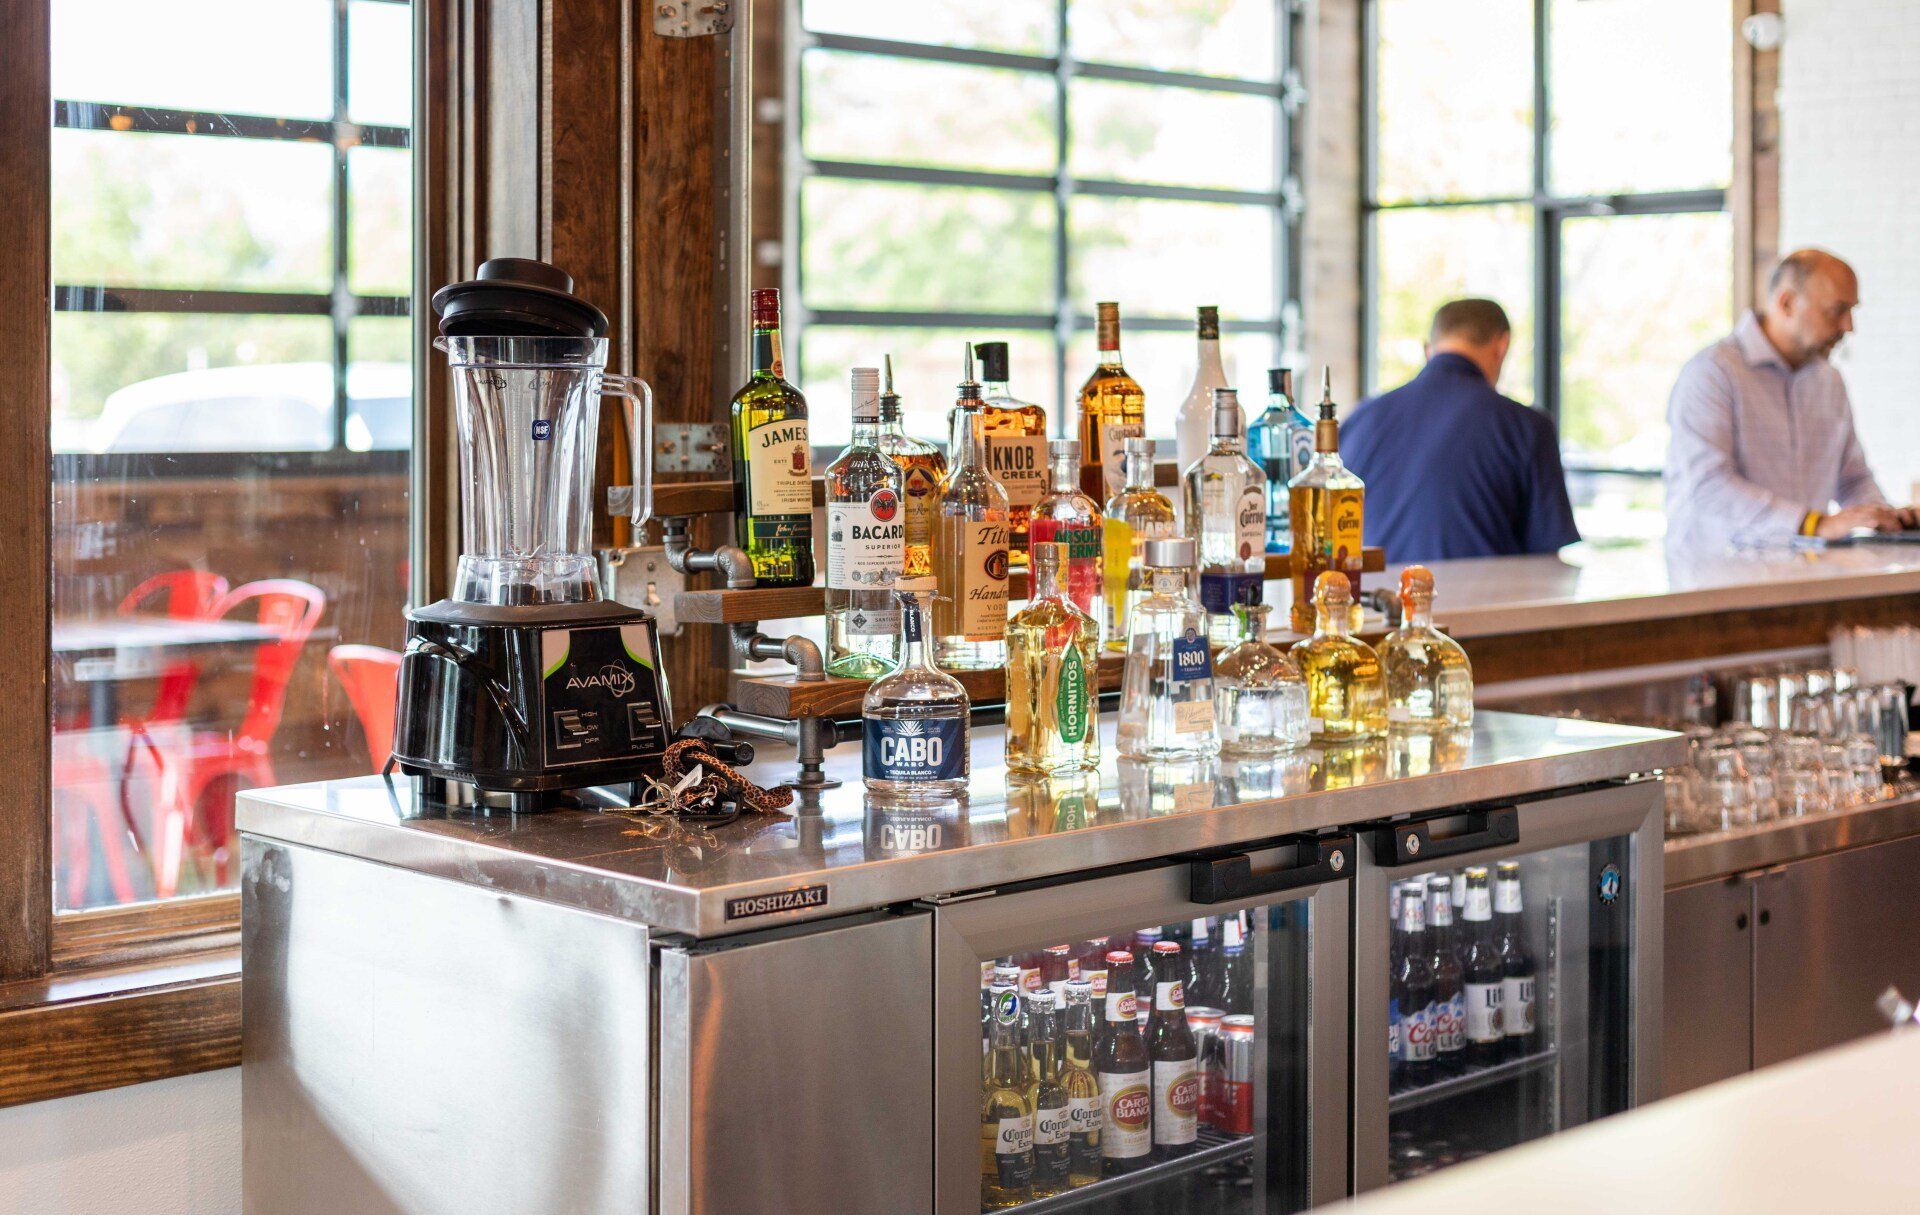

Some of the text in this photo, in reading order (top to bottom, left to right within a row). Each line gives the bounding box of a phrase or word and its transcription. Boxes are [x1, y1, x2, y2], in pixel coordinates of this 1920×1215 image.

[535, 425, 549, 435] NSF
[993, 446, 1034, 470] KNOB
[1002, 471, 1041, 480] CREEK
[852, 525, 904, 540] BACARD
[1178, 649, 1205, 667] 1800
[566, 672, 634, 690] AVAMIX
[1068, 660, 1078, 737] HORNITOS
[631, 742, 655, 750] PULSE
[881, 736, 943, 767] CABO
[734, 889, 823, 916] HOSHIZAKI
